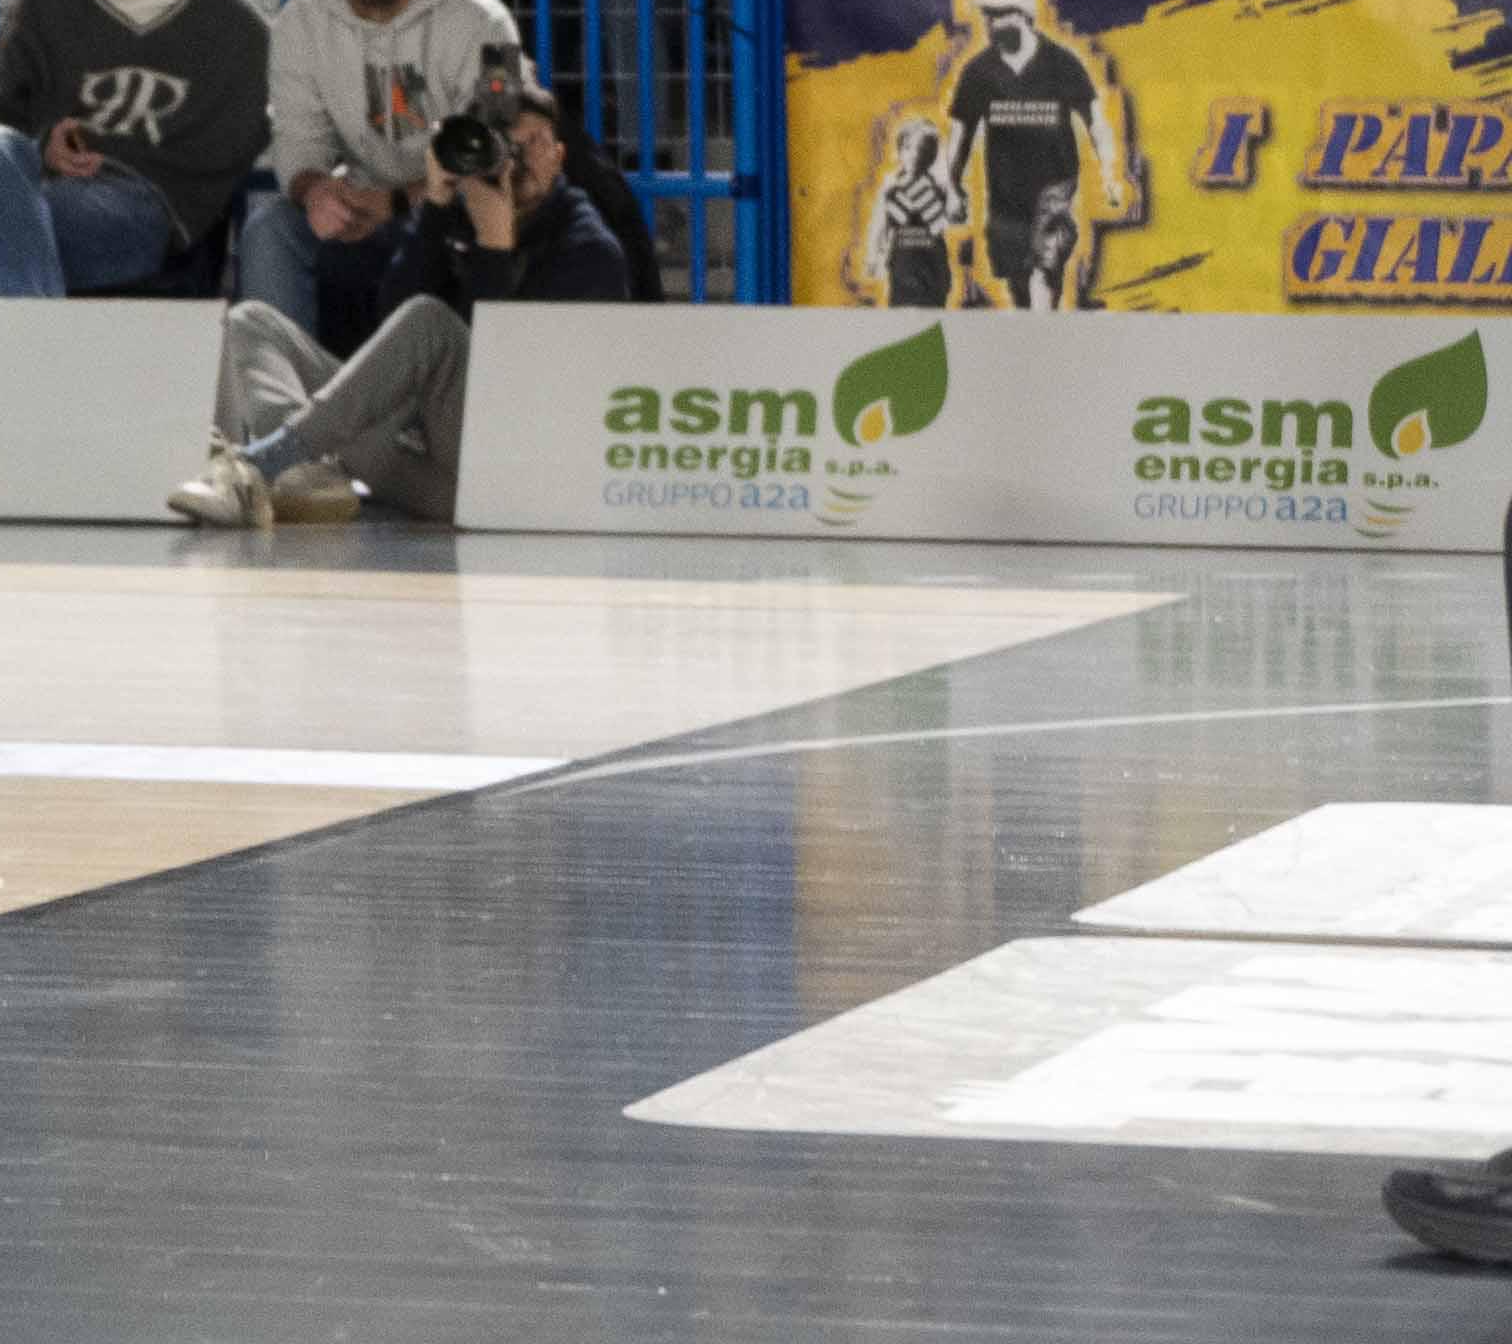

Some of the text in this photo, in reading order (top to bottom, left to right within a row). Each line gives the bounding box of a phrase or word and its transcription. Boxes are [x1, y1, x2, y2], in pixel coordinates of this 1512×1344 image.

[602, 384, 818, 439] asm
[1131, 394, 1354, 450] asm
[604, 431, 899, 480] energia s.p.a.
[1133, 444, 1440, 491] energia s.p.a.
[601, 479, 811, 512] GRUPPO a2a
[1132, 491, 1347, 524] GRUPPO a2a
